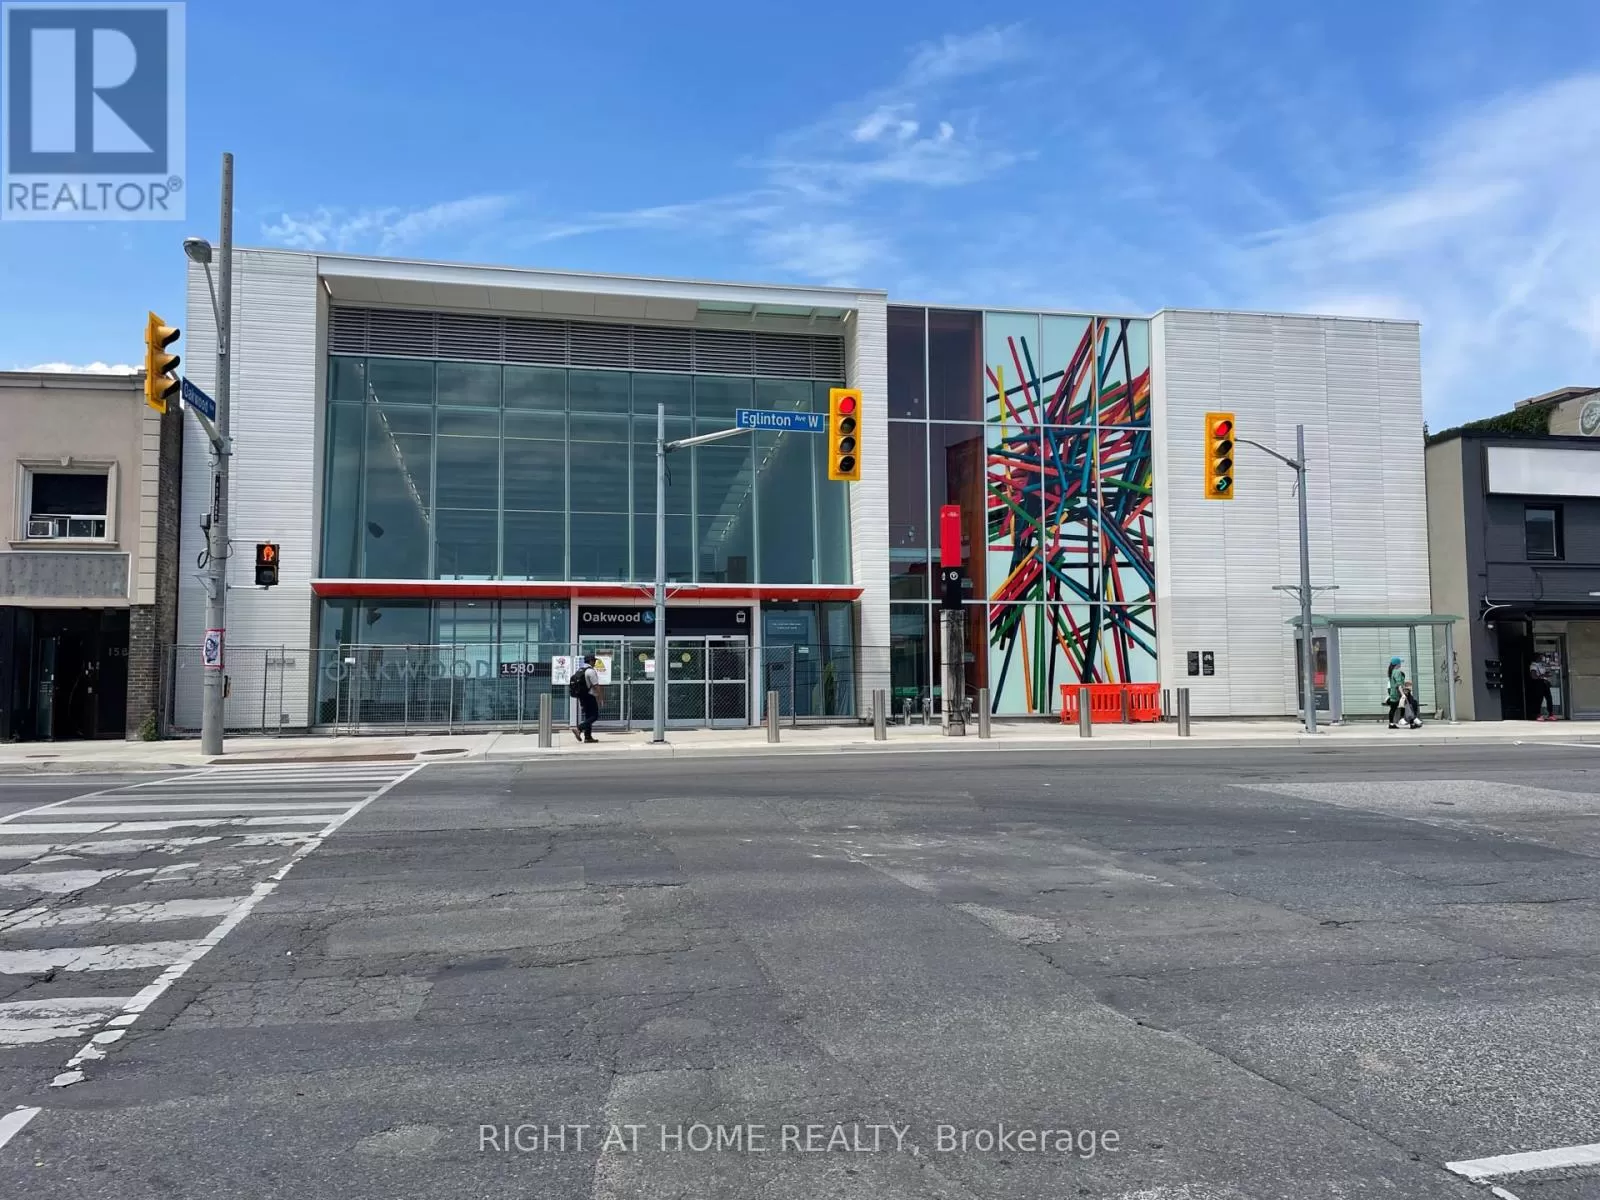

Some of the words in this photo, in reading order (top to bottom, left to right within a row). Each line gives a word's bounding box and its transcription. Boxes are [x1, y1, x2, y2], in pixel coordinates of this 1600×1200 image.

[742, 411, 791, 428] Eglinton
[794, 414, 807, 422] Ave
[808, 415, 819, 428] W
[582, 611, 641, 622] Oakwood
[501, 663, 535, 674] 1580
